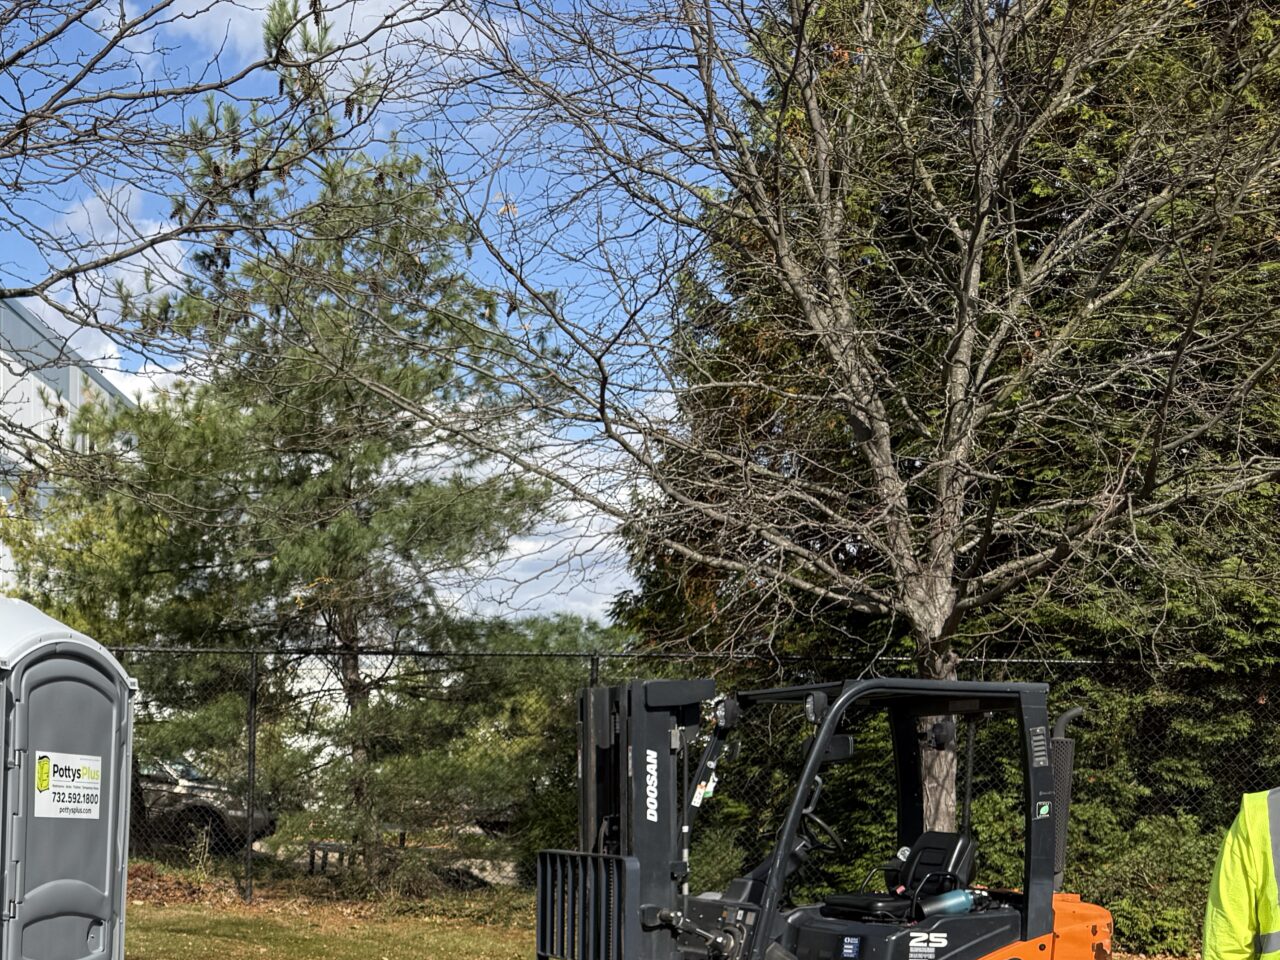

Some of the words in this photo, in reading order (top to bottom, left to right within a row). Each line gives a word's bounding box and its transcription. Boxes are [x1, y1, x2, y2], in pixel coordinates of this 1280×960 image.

[52, 764, 100, 782] PottysPlus
[646, 748, 658, 823] DOOSAN
[52, 792, 99, 804] 732.592.1800
[59, 806, 91, 815] pottysplus.com
[909, 932, 948, 948] 25
